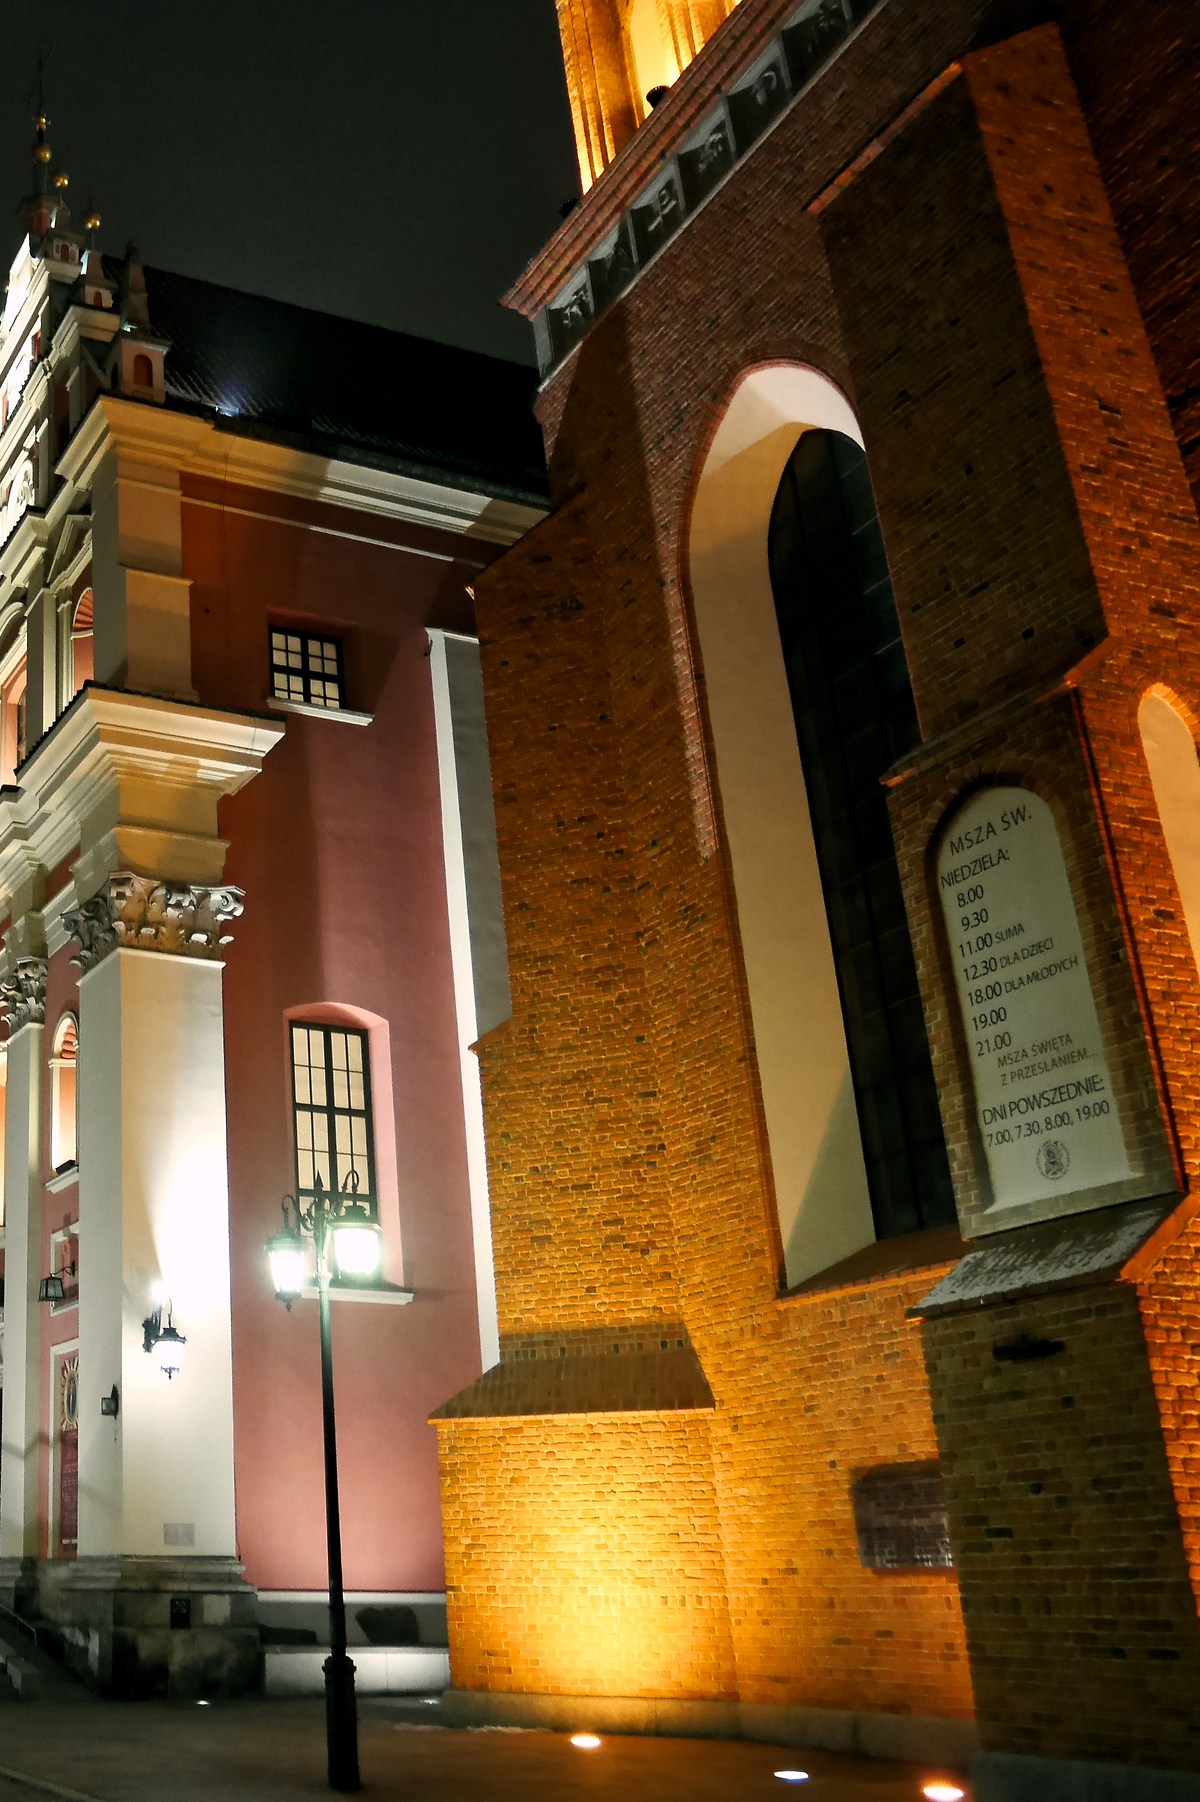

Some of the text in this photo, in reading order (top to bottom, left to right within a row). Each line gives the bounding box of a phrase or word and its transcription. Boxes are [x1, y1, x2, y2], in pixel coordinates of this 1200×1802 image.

[950, 822, 997, 856] MSZA
[941, 849, 1010, 888] NIEDZIELA:
[957, 885, 984, 908] 8.00
[961, 908, 988, 932] 9.30
[959, 923, 1024, 958] 11.00 SUMA
[963, 937, 1054, 982] 12.30 DLA DZIECI
[968, 982, 1002, 1006] 18.00
[1005, 976, 1026, 993] DLA
[972, 1006, 1007, 1031] 19.00
[975, 1031, 1012, 1057] 21.00
[997, 1049, 1029, 1068] MSZA
[1000, 1074, 1008, 1087] Z
[982, 1074, 1104, 1126] DNI POWSZEDNIE:
[1075, 1100, 1110, 1121] 19.00
